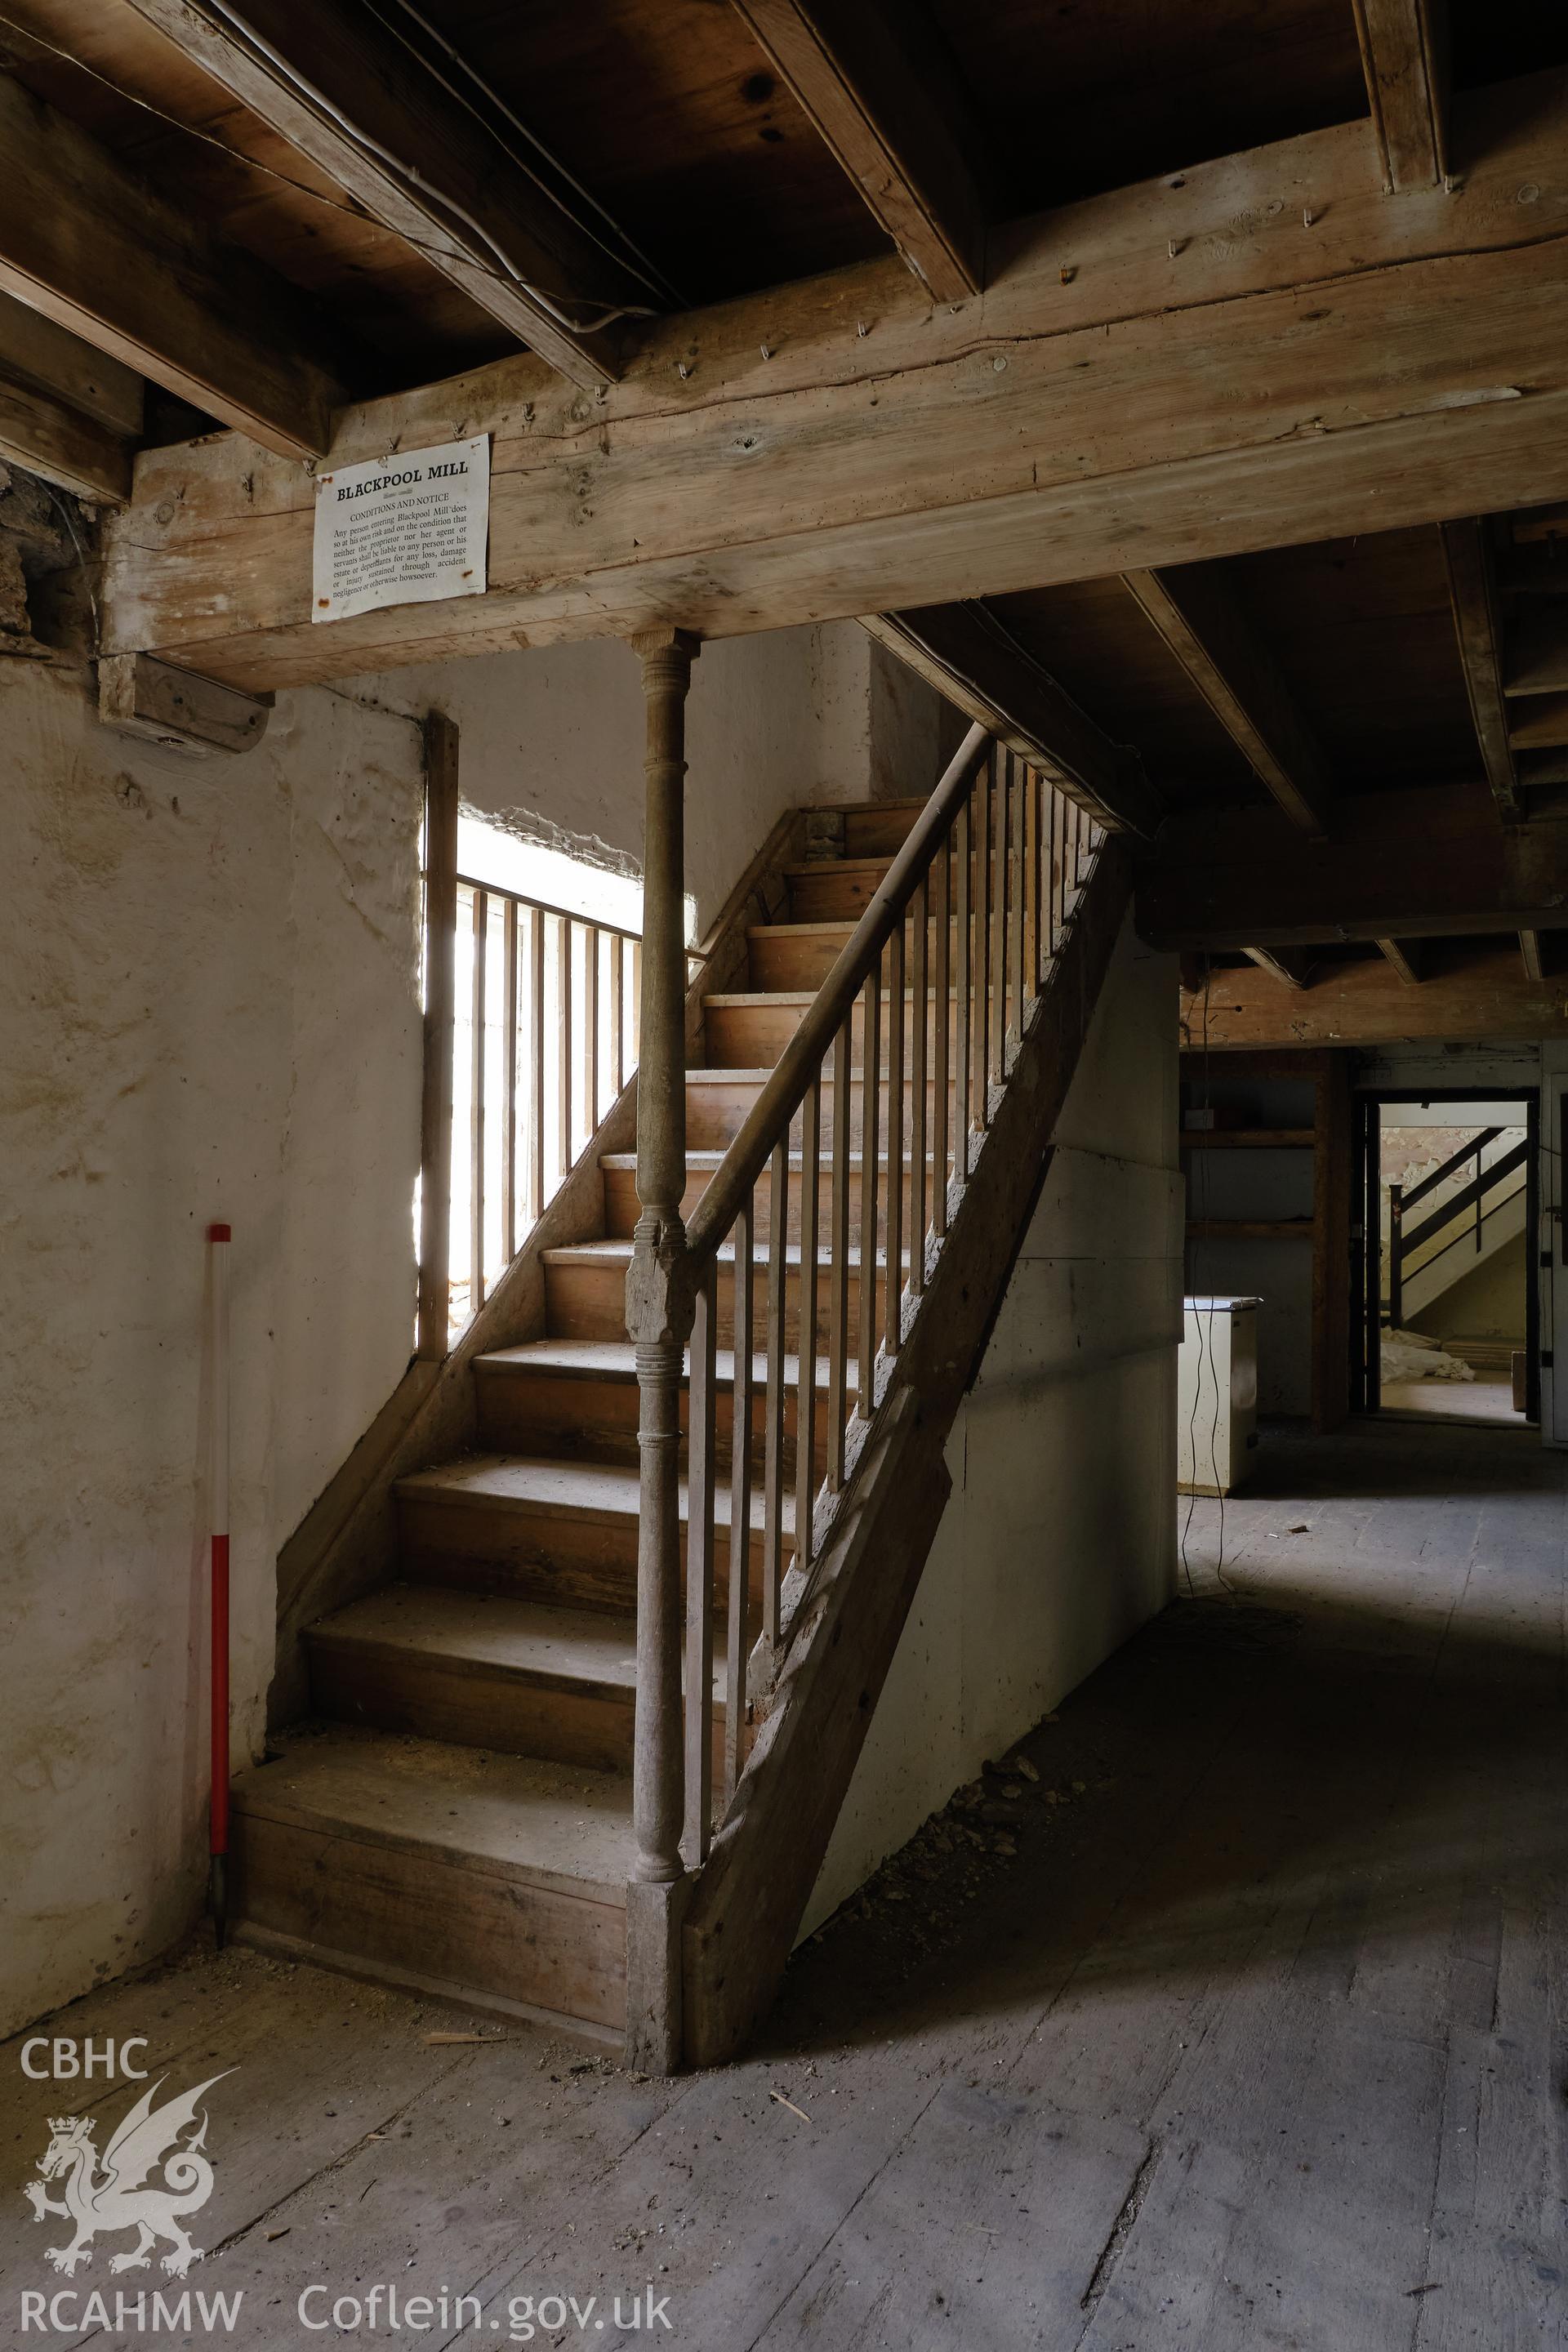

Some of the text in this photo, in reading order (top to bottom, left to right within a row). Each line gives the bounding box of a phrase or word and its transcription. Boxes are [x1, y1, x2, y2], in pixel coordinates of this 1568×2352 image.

[336, 461, 468, 501] BLACKPOOL MILL
[333, 504, 467, 538] Any person entering Blackpool Mill does
[350, 492, 449, 522] CONDITIONS AND NOTICE
[333, 548, 355, 559] neither
[359, 544, 368, 553] the
[370, 534, 399, 551] proprietor
[421, 531, 432, 539] her
[436, 527, 455, 538] agent
[459, 525, 467, 533] or
[350, 537, 359, 546] his
[359, 534, 372, 543] own
[372, 529, 383, 538] risk
[383, 524, 395, 535] and
[407, 521, 420, 530] the
[419, 517, 452, 528] condition
[453, 514, 467, 523] that
[333, 558, 358, 568] servants
[359, 552, 372, 563] shall
[372, 549, 380, 558] be
[380, 545, 397, 556] liable
[399, 543, 406, 551] to
[407, 541, 421, 551] any
[421, 538, 445, 550] person
[457, 536, 467, 544] his
[333, 568, 350, 578] estate
[394, 554, 404, 563] for
[407, 554, 420, 563] any
[422, 550, 438, 559] loss,
[440, 548, 467, 558] damage
[332, 572, 438, 599] negligence or otherwise howsoever.
[346, 574, 363, 586] injury
[368, 565, 394, 579] sustained
[402, 562, 430, 572] through
[437, 557, 466, 568] accident
